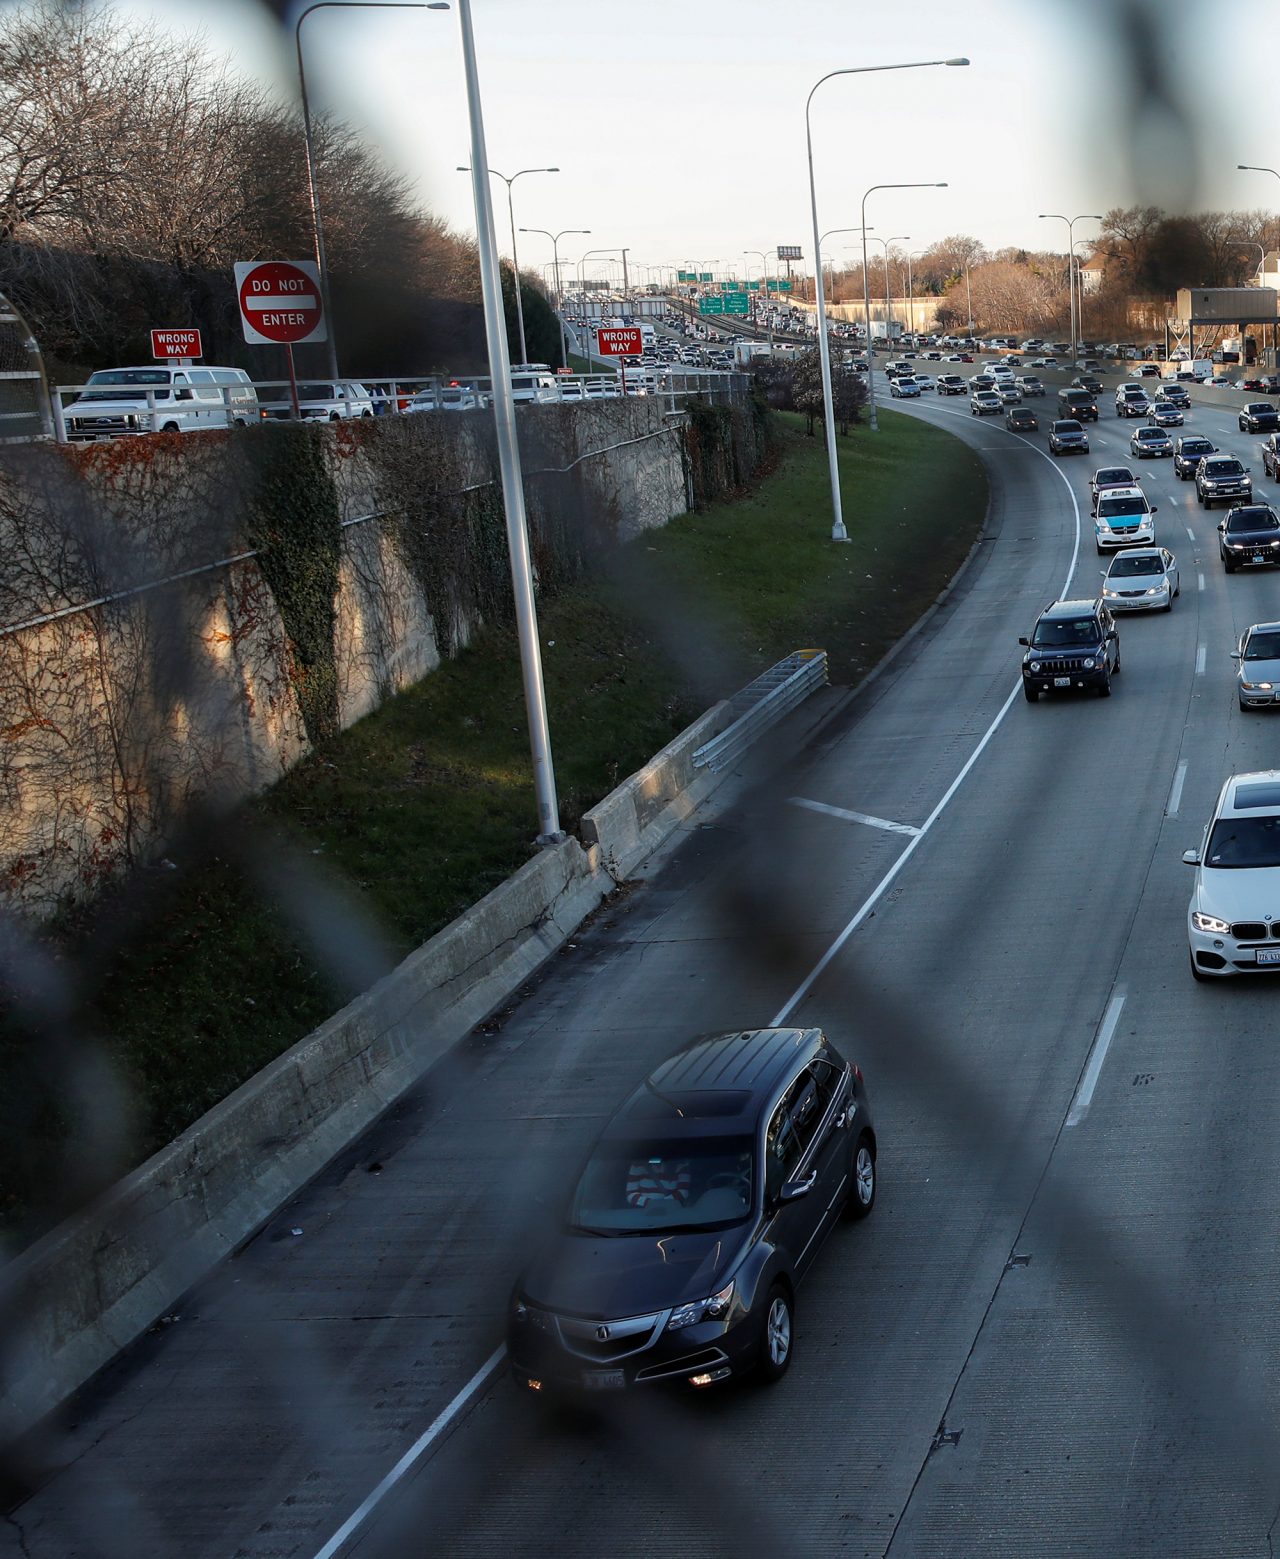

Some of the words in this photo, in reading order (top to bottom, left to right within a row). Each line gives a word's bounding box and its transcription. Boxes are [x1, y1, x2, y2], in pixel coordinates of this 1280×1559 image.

[252, 280, 271, 292] DO
[279, 279, 305, 291] NOT
[262, 313, 306, 326] ENTER
[157, 333, 195, 343] WRONG
[602, 332, 637, 341] WRONG
[166, 345, 188, 354] WAY
[610, 342, 630, 352] WAY
